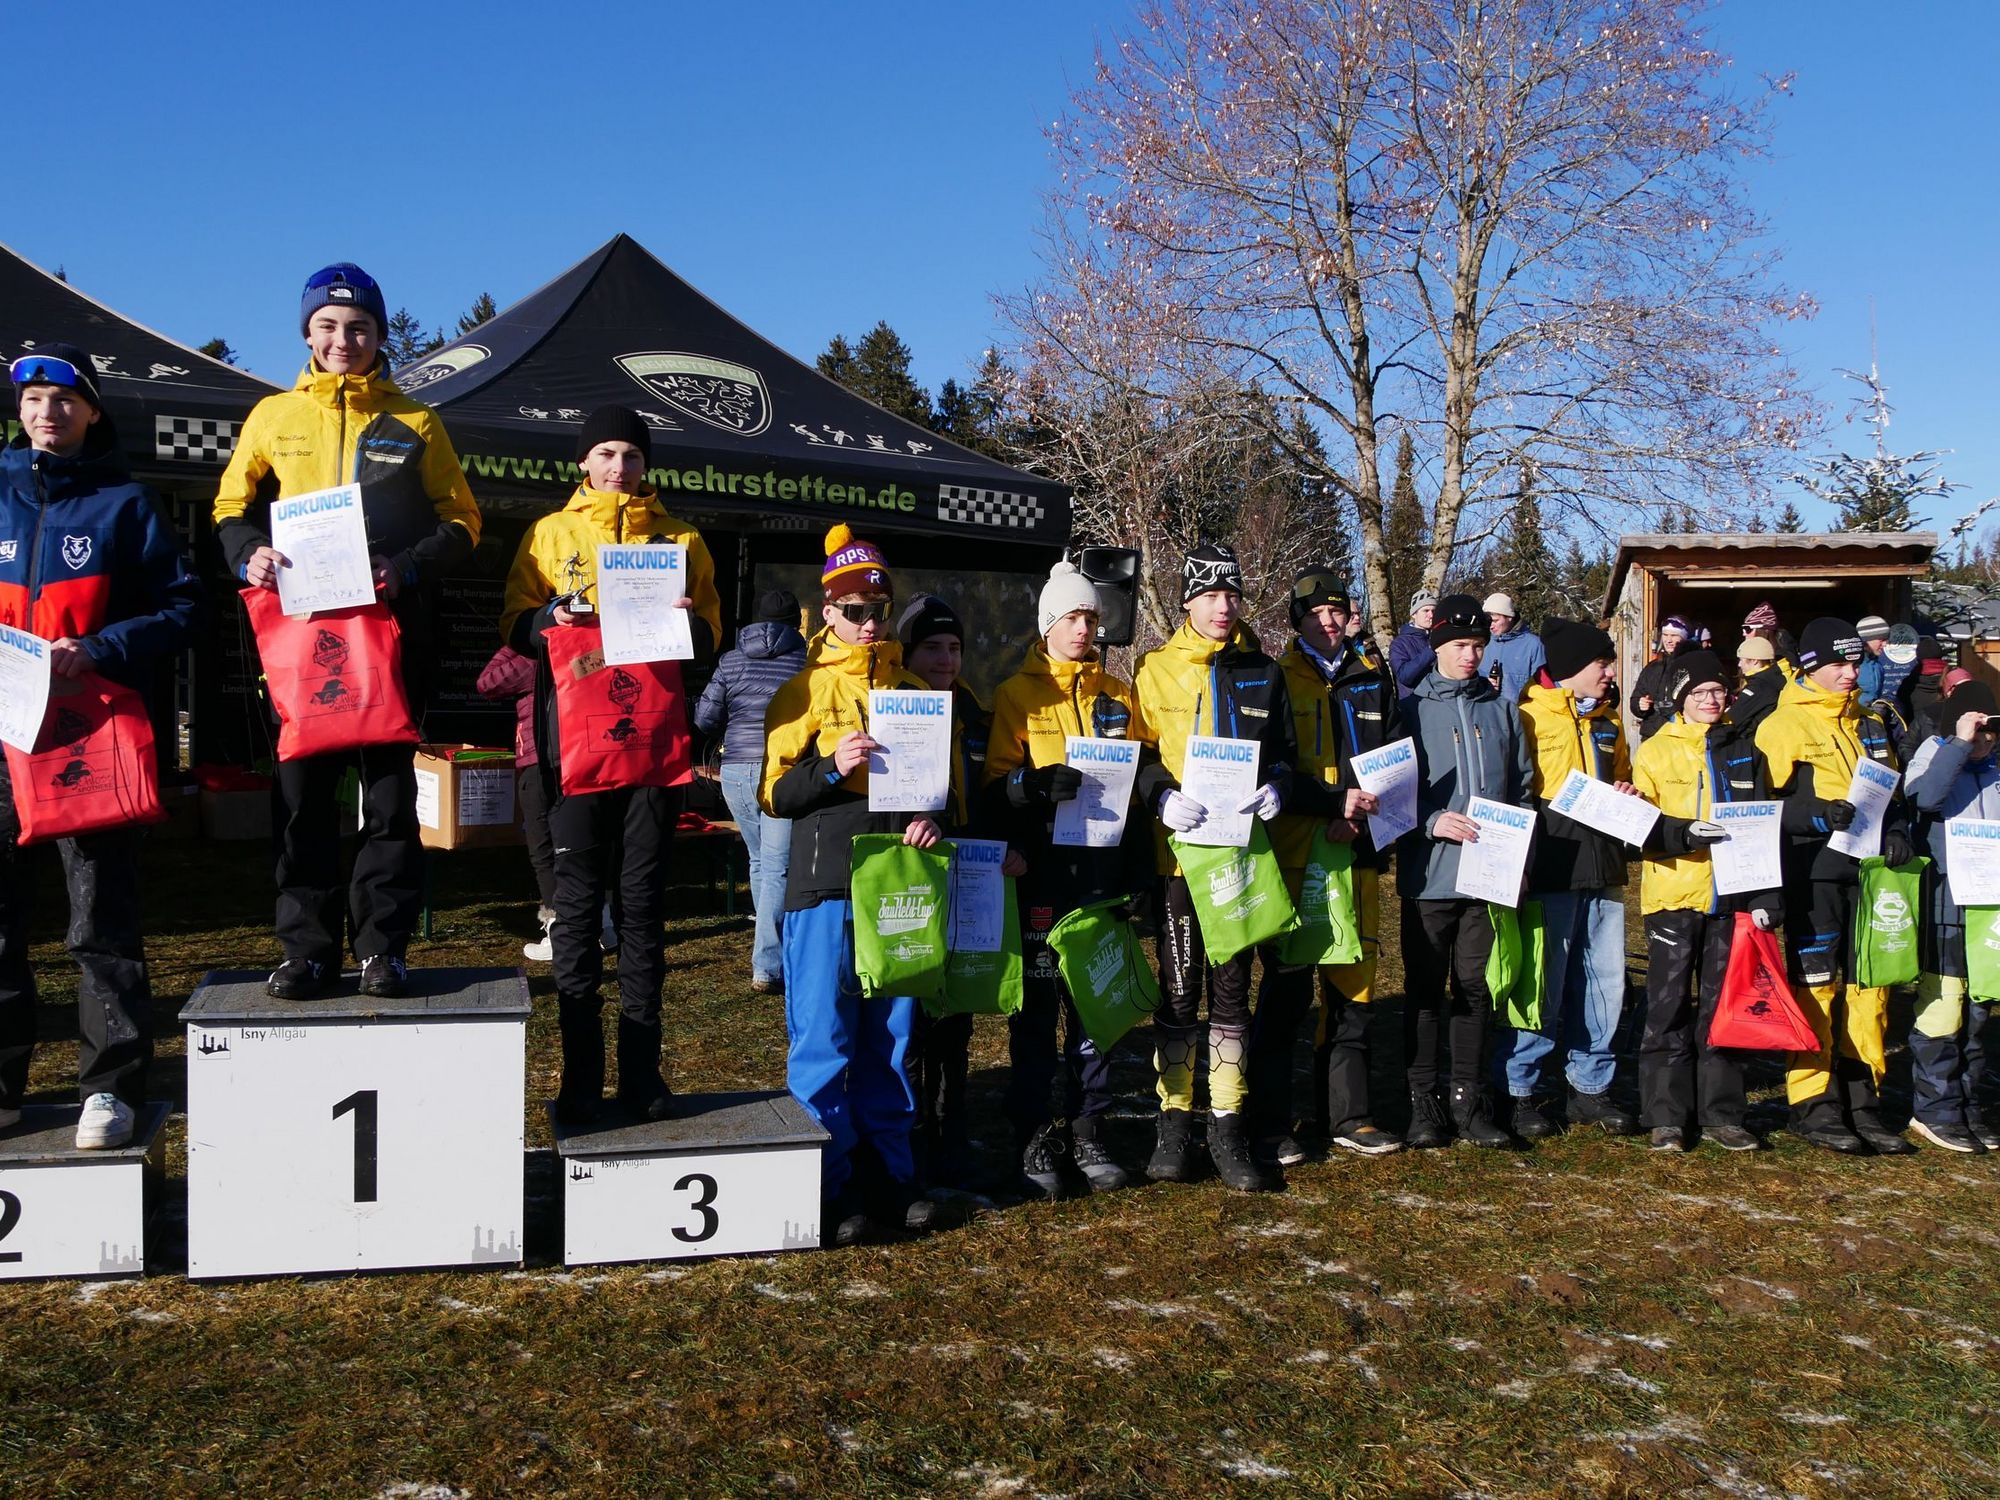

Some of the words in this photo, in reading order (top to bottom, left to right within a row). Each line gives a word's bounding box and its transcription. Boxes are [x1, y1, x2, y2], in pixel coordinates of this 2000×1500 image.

[632, 357, 751, 381] MEHRSTETTEN
[277, 491, 354, 521] URKUNDE
[603, 551, 679, 570] URKUNDE
[836, 548, 869, 567] RPS
[875, 696, 945, 716] URKUNDE
[1071, 742, 1133, 764] URKUNDE
[1191, 741, 1254, 763] URKUNDE
[1357, 745, 1412, 776] URKUNDE
[1859, 763, 1896, 790] URKUNDE
[1556, 775, 1589, 813] URKUNDE
[1472, 803, 1530, 830] URKUNDE
[1714, 804, 1776, 820] URKUNDE
[952, 845, 1001, 864] KUNDE
[241, 1028, 266, 1041] Isny
[269, 1027, 307, 1041] Allgäu
[333, 1090, 377, 1202] 1
[601, 1159, 621, 1169] Isny
[671, 1173, 719, 1243] 3
